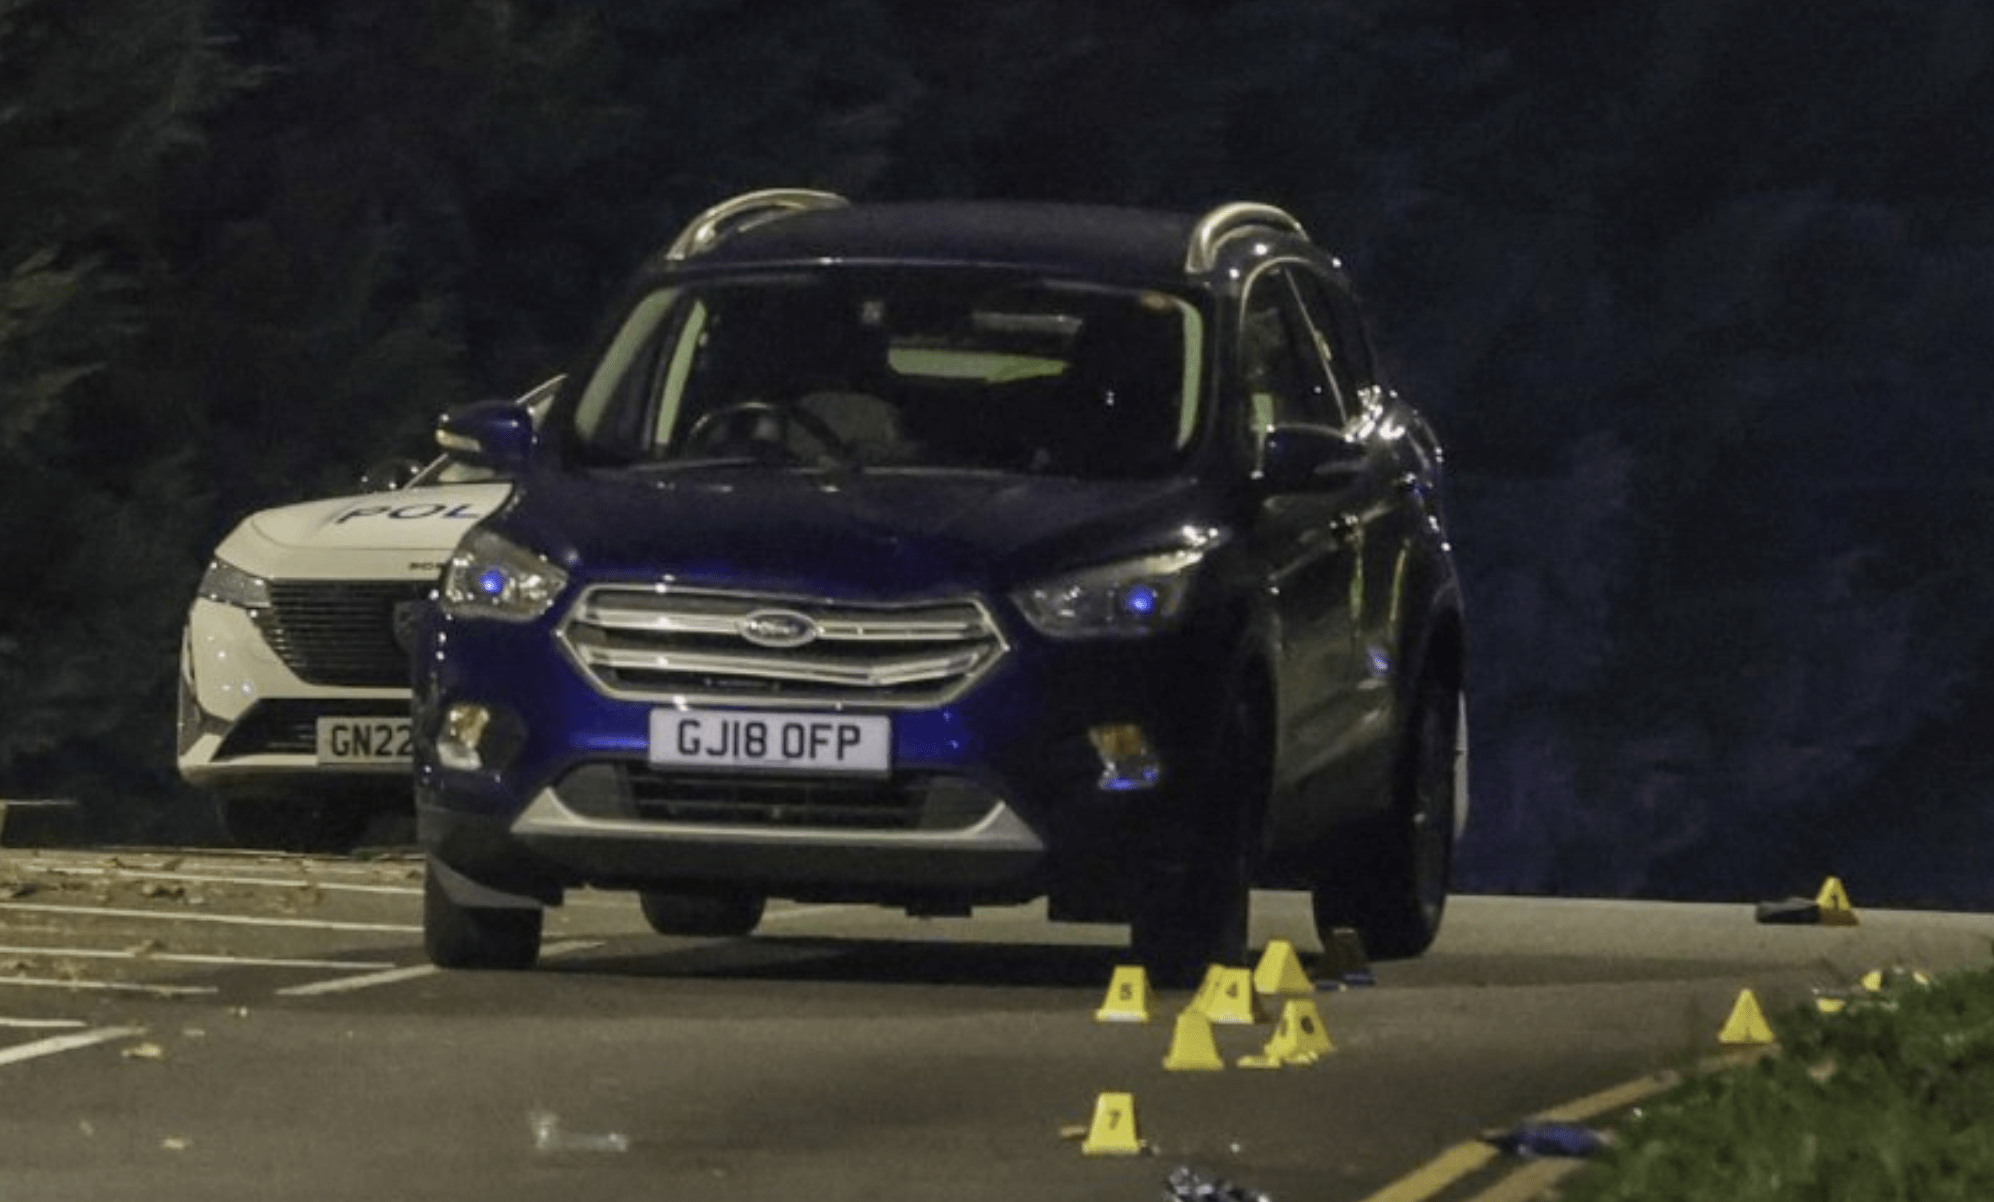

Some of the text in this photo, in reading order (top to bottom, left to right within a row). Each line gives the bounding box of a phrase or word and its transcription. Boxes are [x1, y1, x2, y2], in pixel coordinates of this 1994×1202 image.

[332, 724, 412, 757] GN22
[678, 719, 861, 761] GJ18 OFP
[1225, 982, 1238, 999] 4
[1108, 1109, 1122, 1130] 7
